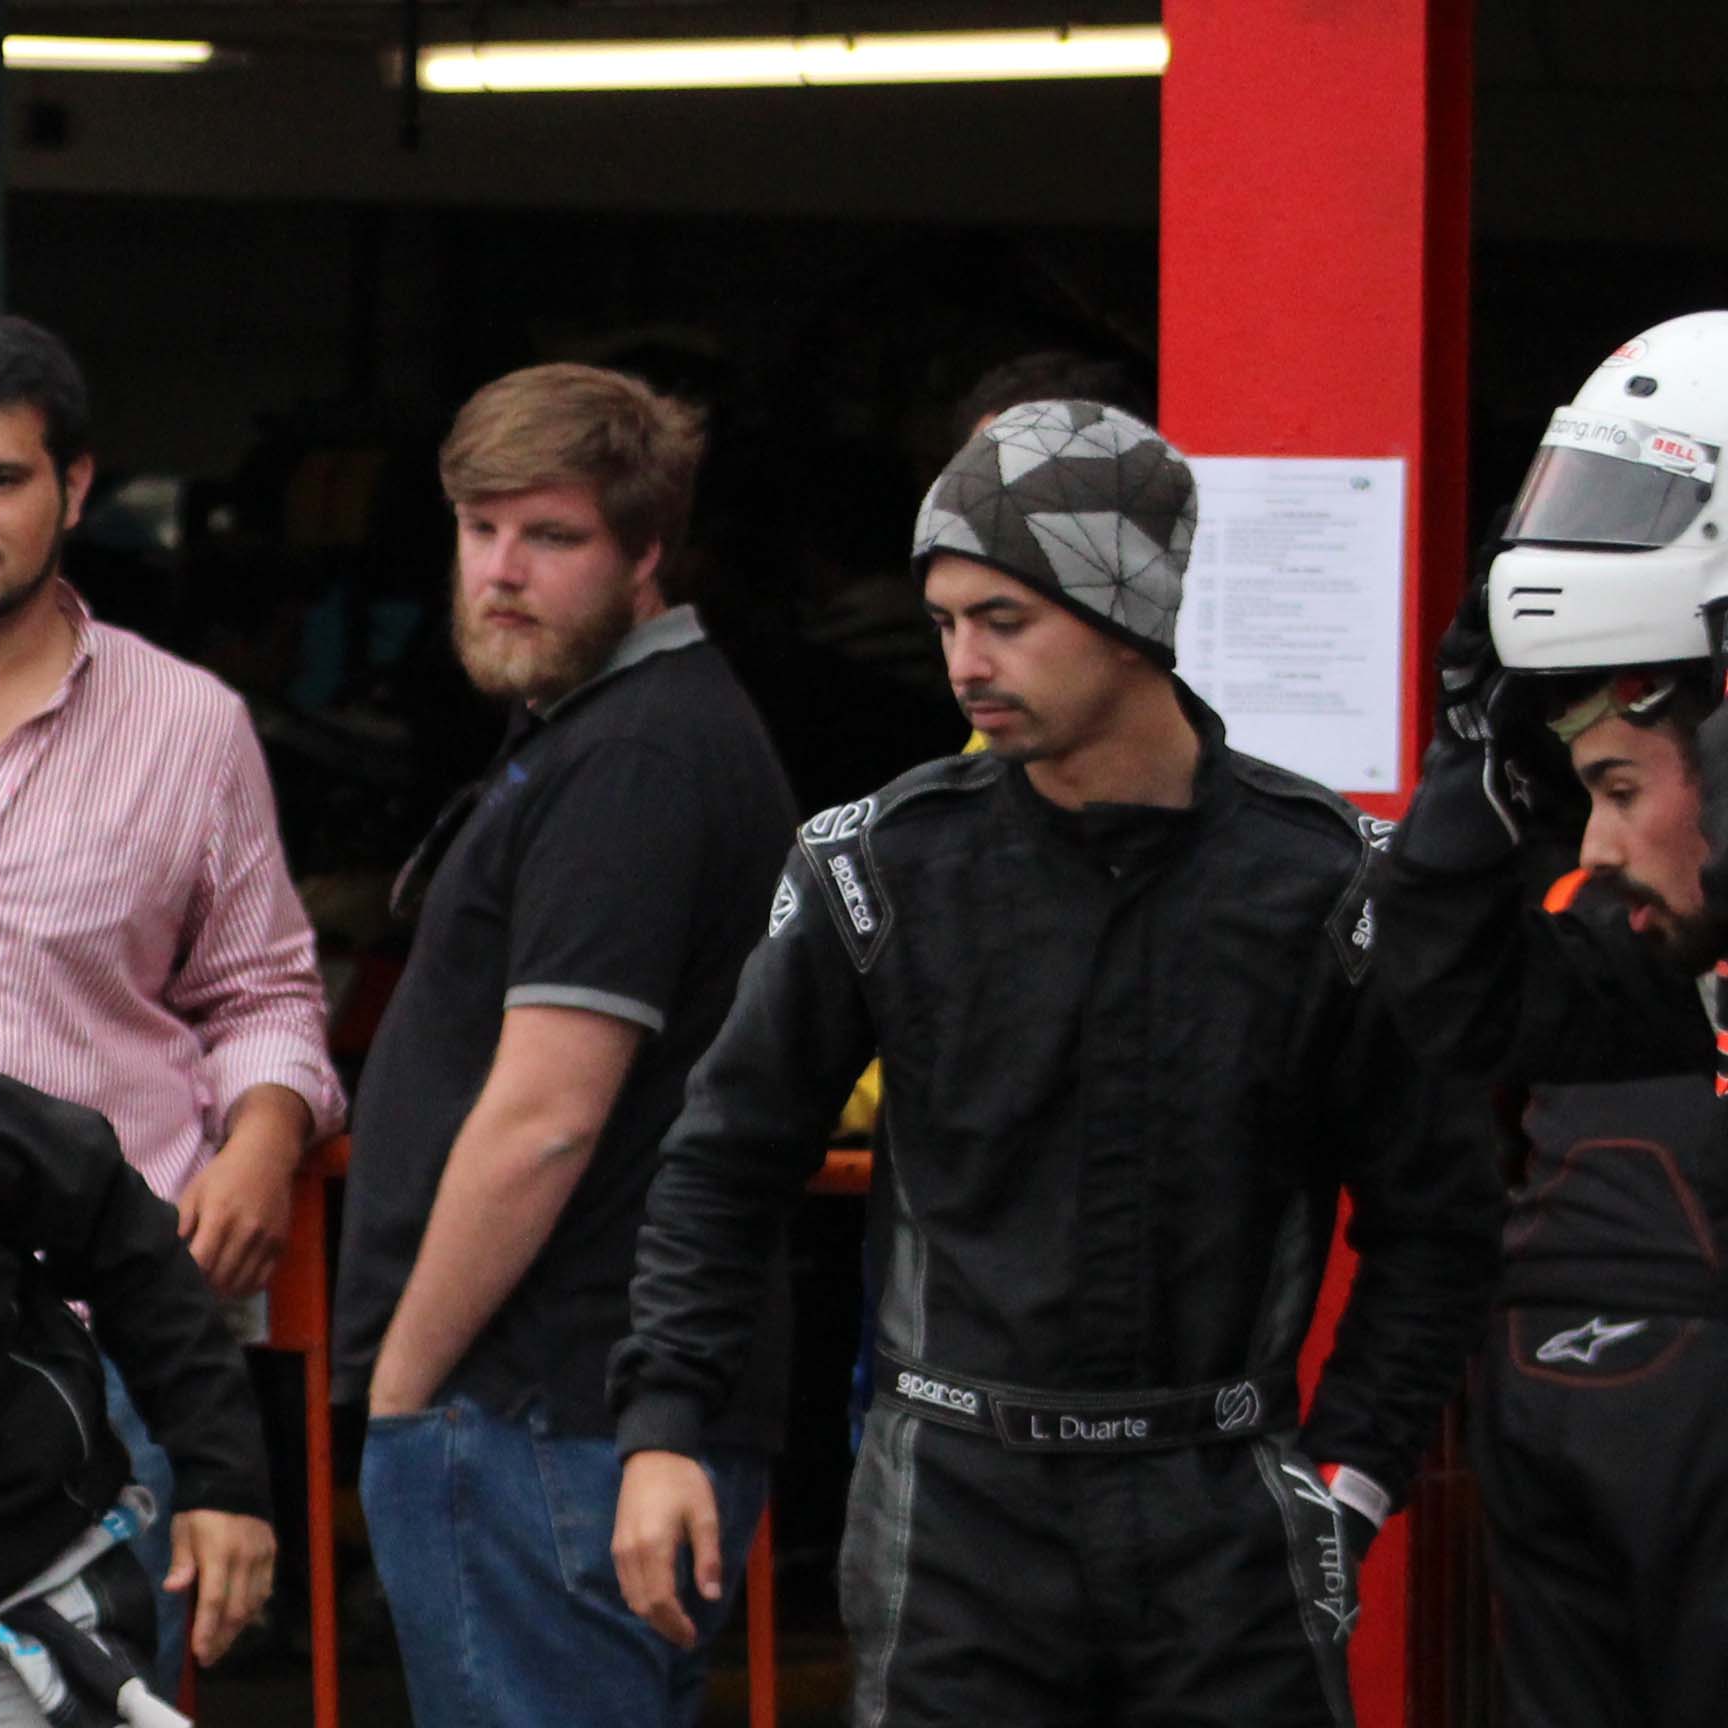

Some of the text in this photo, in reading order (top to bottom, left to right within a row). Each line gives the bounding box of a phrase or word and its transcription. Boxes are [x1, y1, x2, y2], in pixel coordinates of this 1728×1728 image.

[1652, 437, 1696, 463] BELL
[828, 855, 873, 934] sparco
[896, 1371, 1147, 1440] sparco L. Duarte
